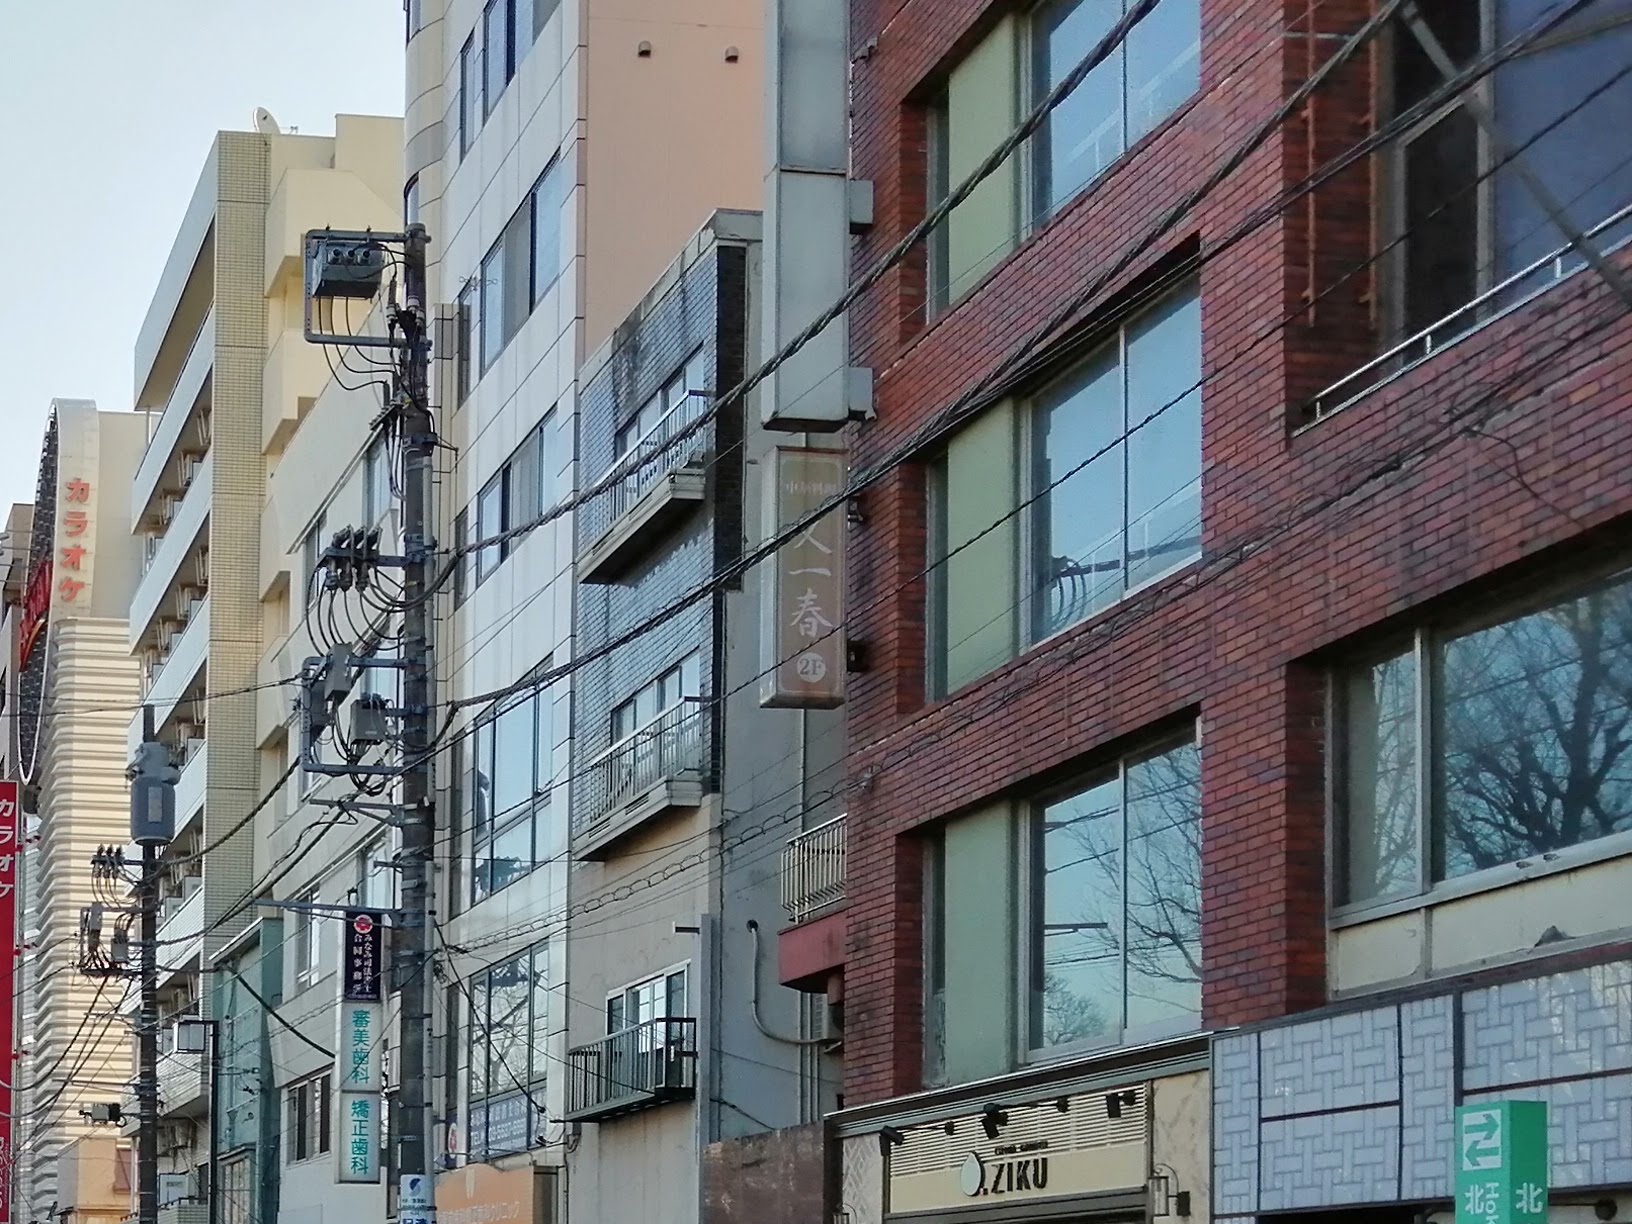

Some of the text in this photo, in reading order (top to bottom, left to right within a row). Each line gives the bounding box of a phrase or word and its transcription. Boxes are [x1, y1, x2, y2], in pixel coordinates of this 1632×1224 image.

[59, 478, 90, 602] カラオケ
[799, 658, 822, 676] 2F
[352, 1009, 370, 1084] 審美歯科
[351, 1100, 369, 1175] 矯正歯科
